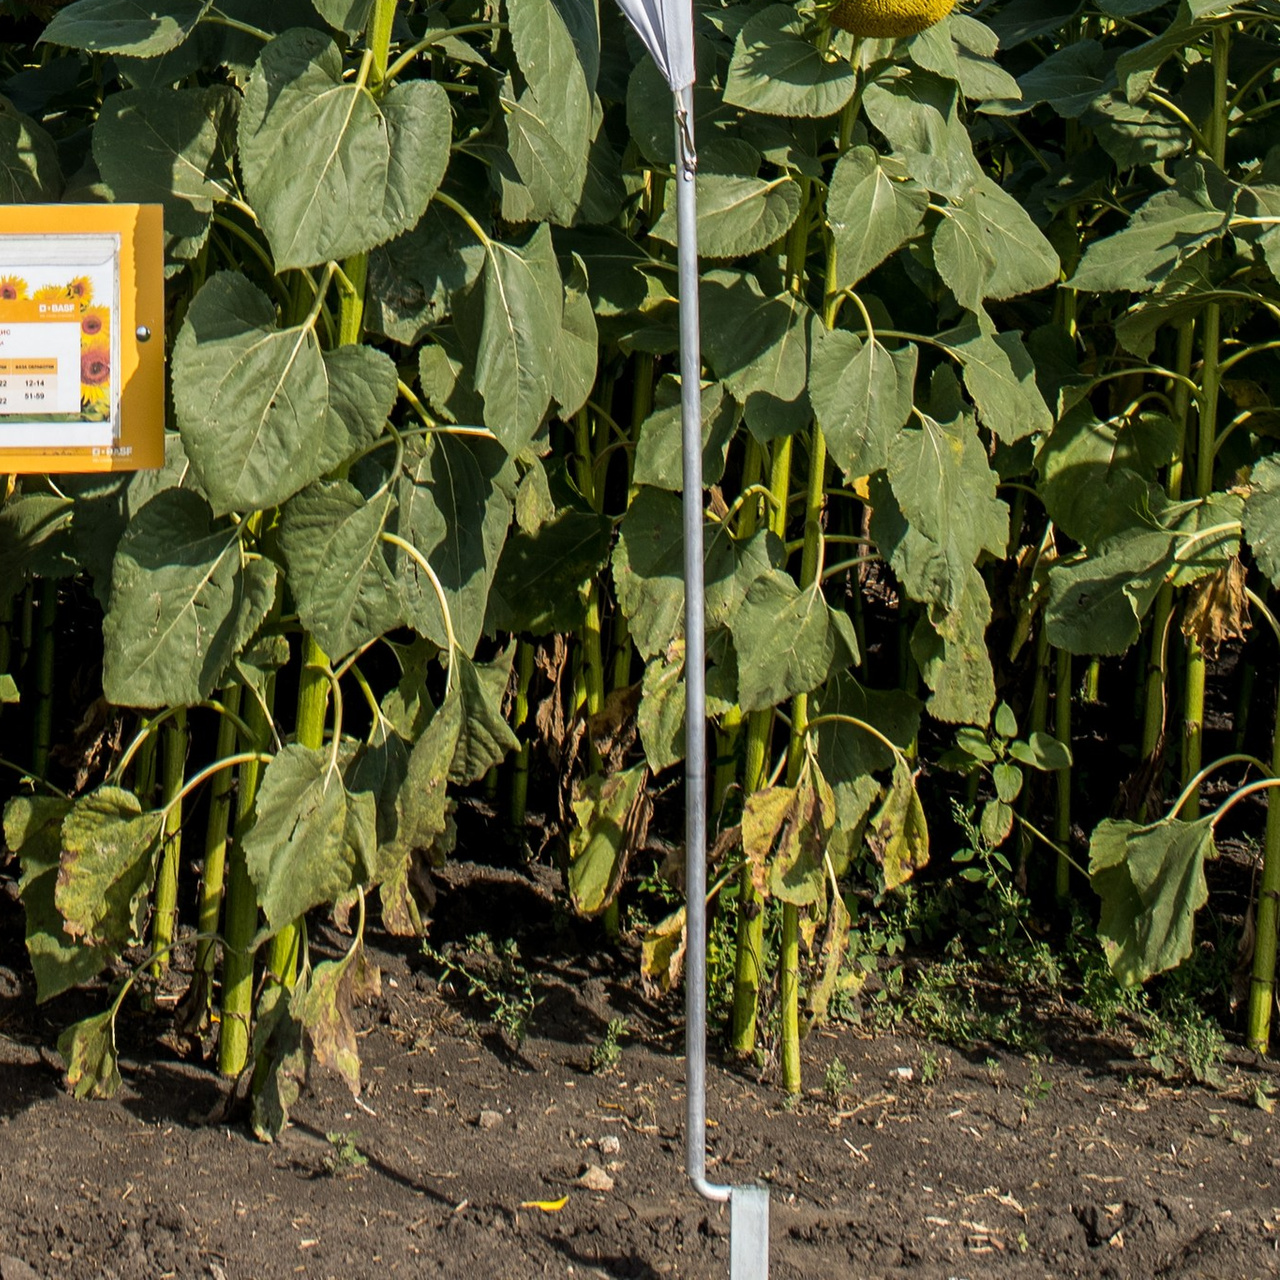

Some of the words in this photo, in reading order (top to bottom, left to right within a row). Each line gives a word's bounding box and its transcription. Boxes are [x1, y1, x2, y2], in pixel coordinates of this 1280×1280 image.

[51, 304, 75, 313] BASF
[25, 379, 45, 387] 12-14
[24, 392, 45, 400] 51-59
